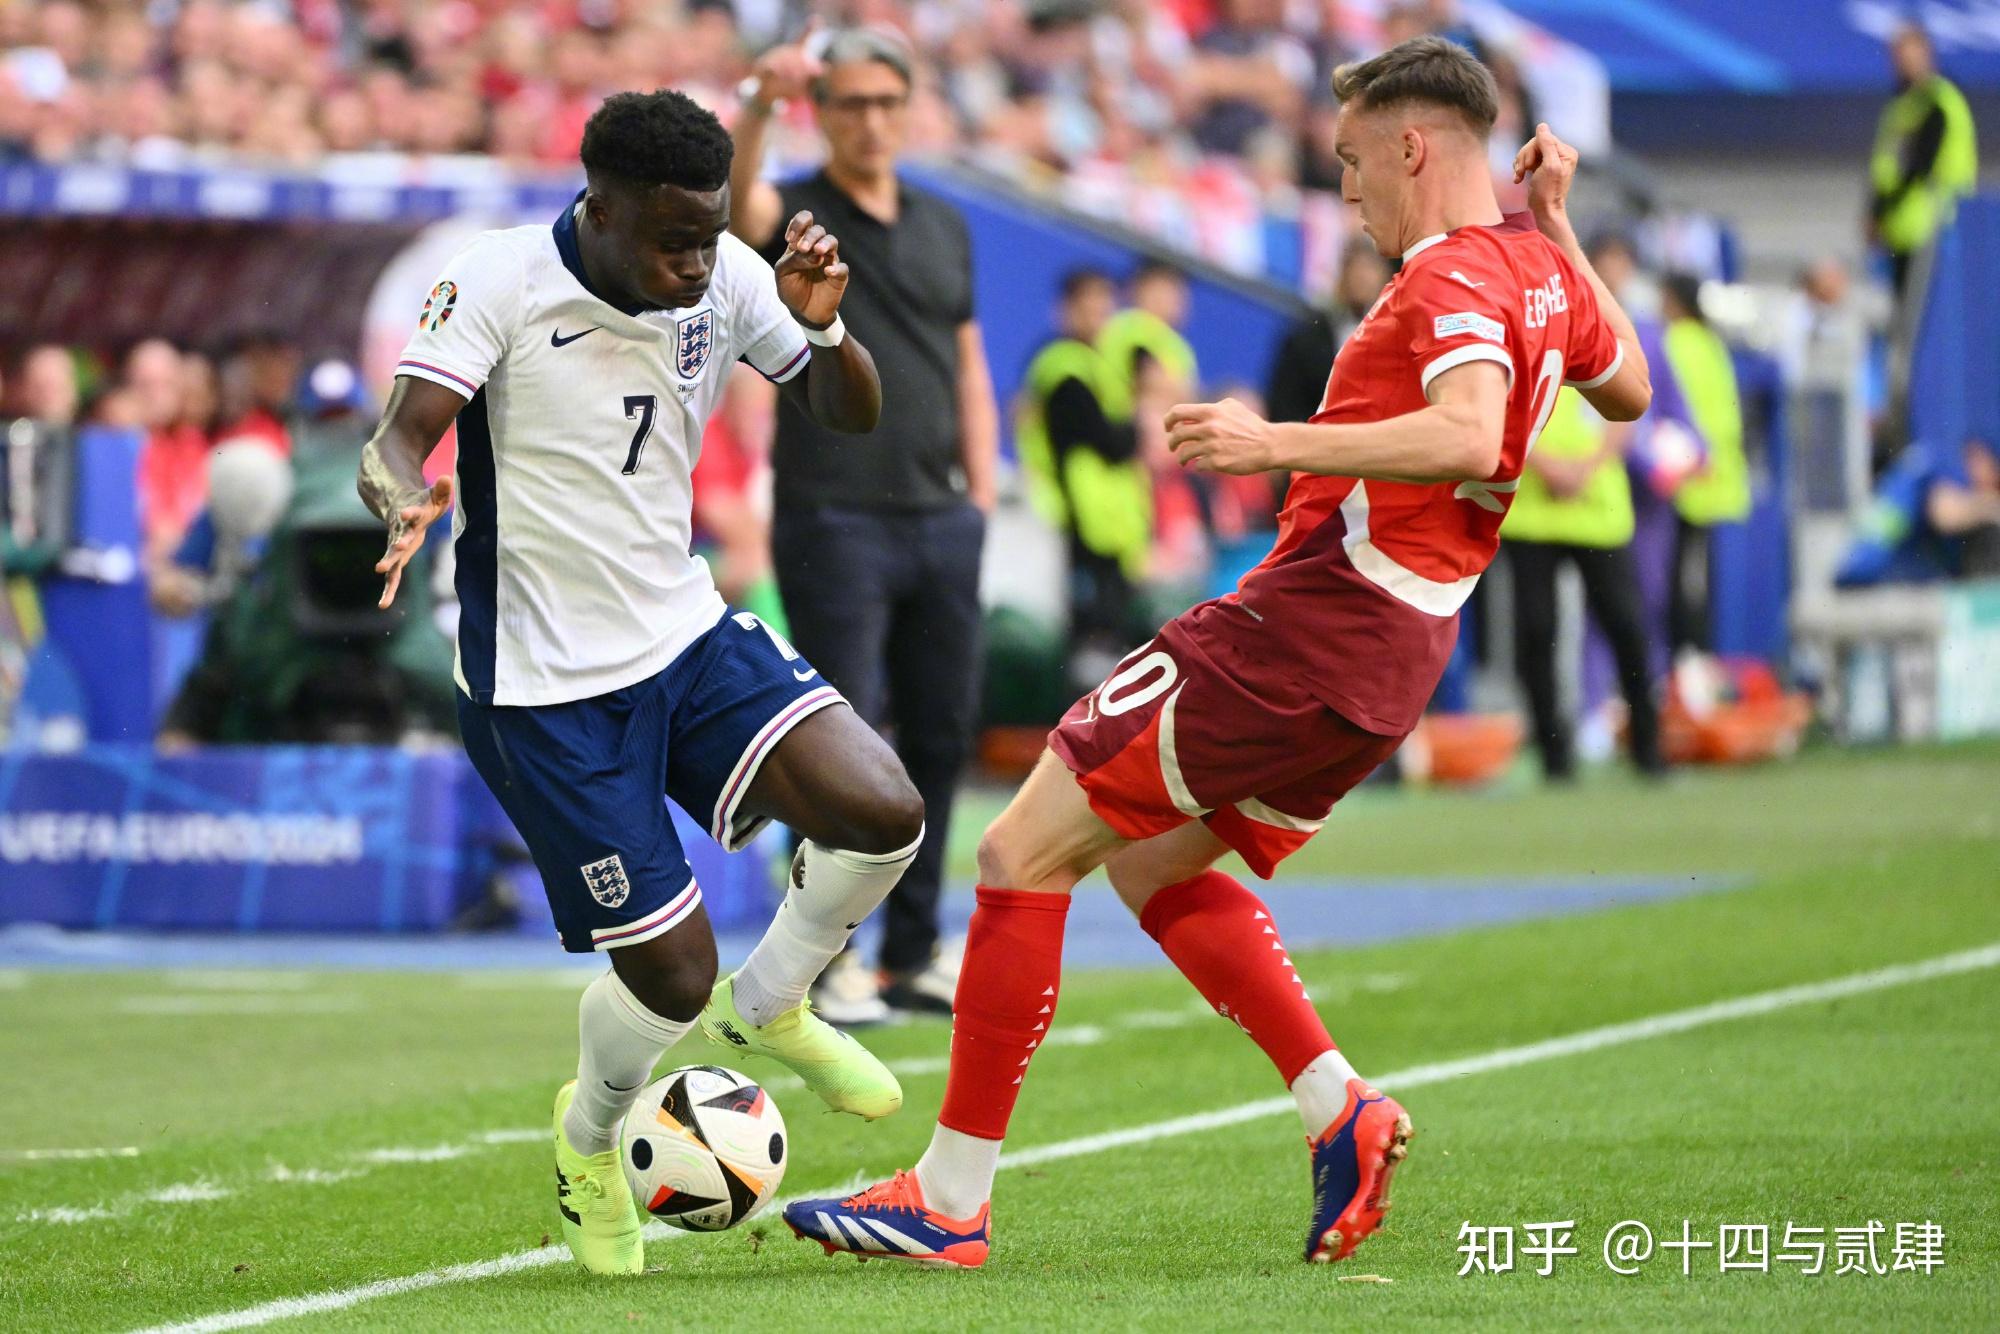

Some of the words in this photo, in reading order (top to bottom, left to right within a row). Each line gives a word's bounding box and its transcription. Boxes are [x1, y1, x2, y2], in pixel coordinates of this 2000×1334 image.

[621, 395, 658, 475] 7
[731, 611, 799, 661] 7
[1098, 639, 1178, 717] 0
[0, 812, 119, 864] UEFA
[122, 812, 260, 864] EURO
